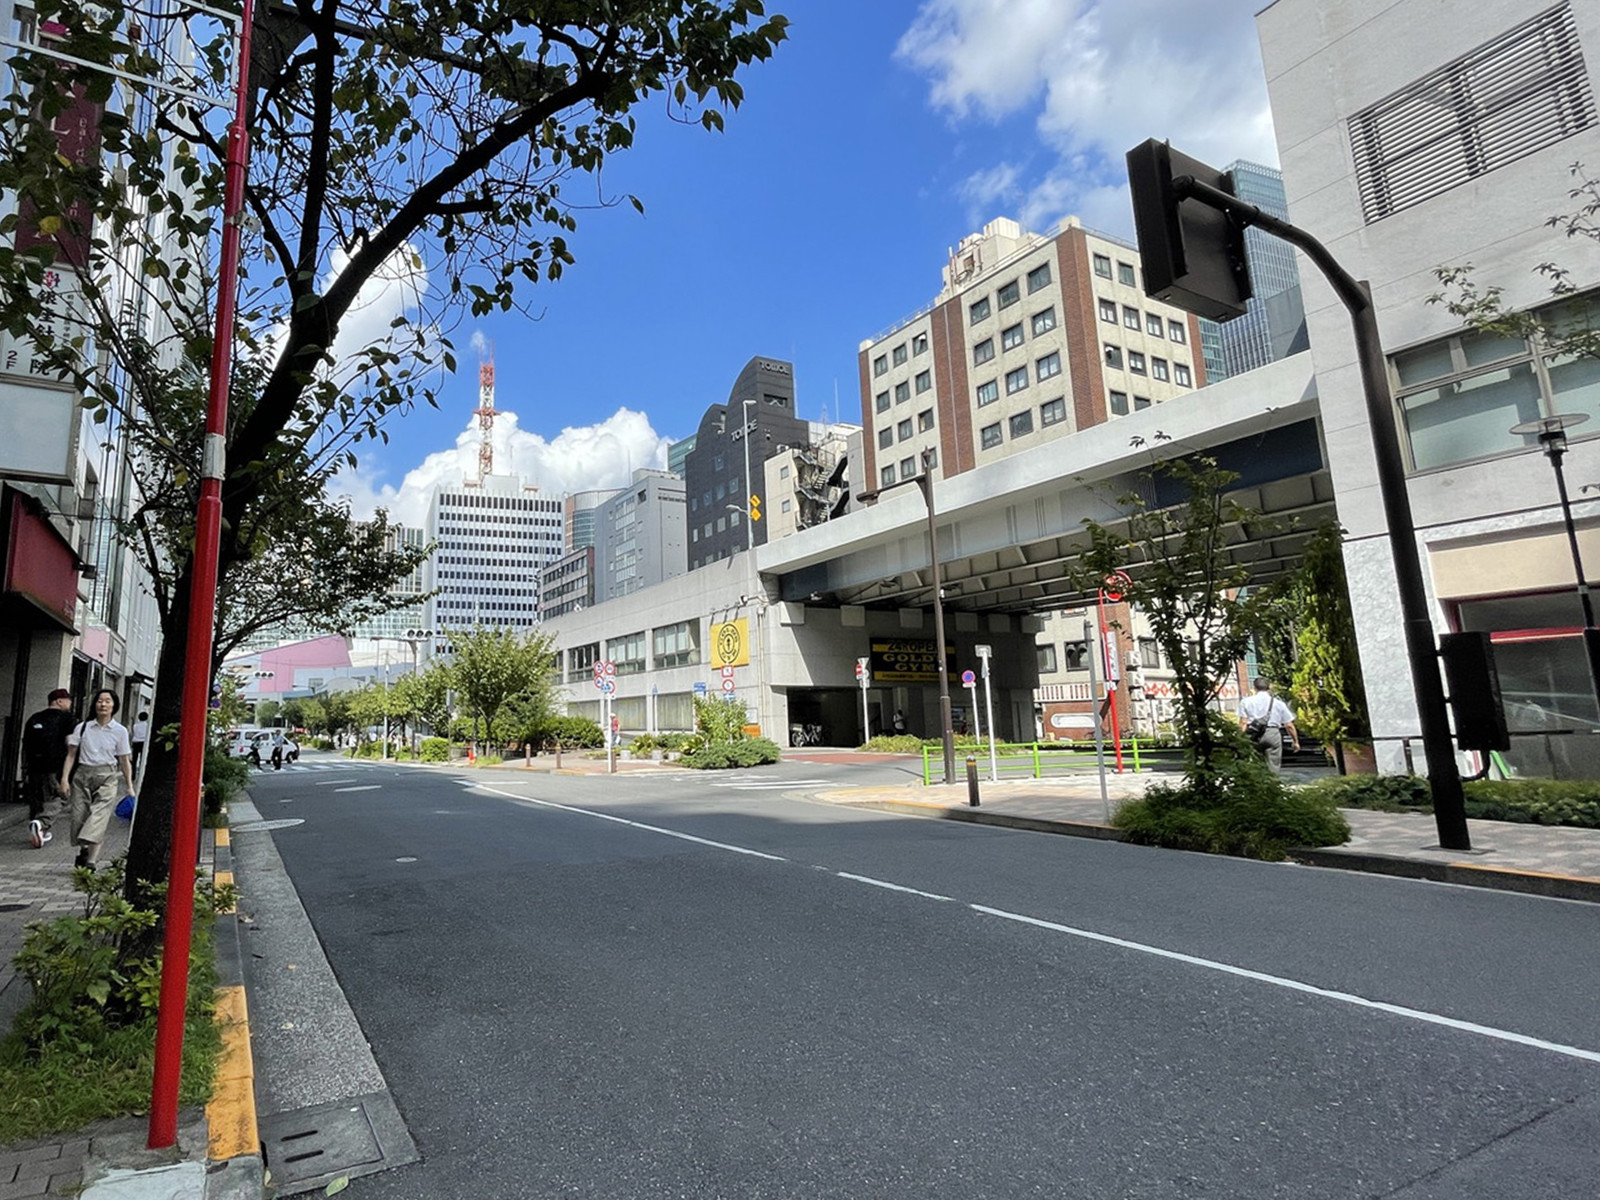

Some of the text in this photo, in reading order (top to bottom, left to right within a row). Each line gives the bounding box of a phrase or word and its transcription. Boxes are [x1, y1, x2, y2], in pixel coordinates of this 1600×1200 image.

[759, 361, 789, 375] TOMOE
[882, 653, 938, 662] GOLD'
[894, 662, 936, 672] GYM
